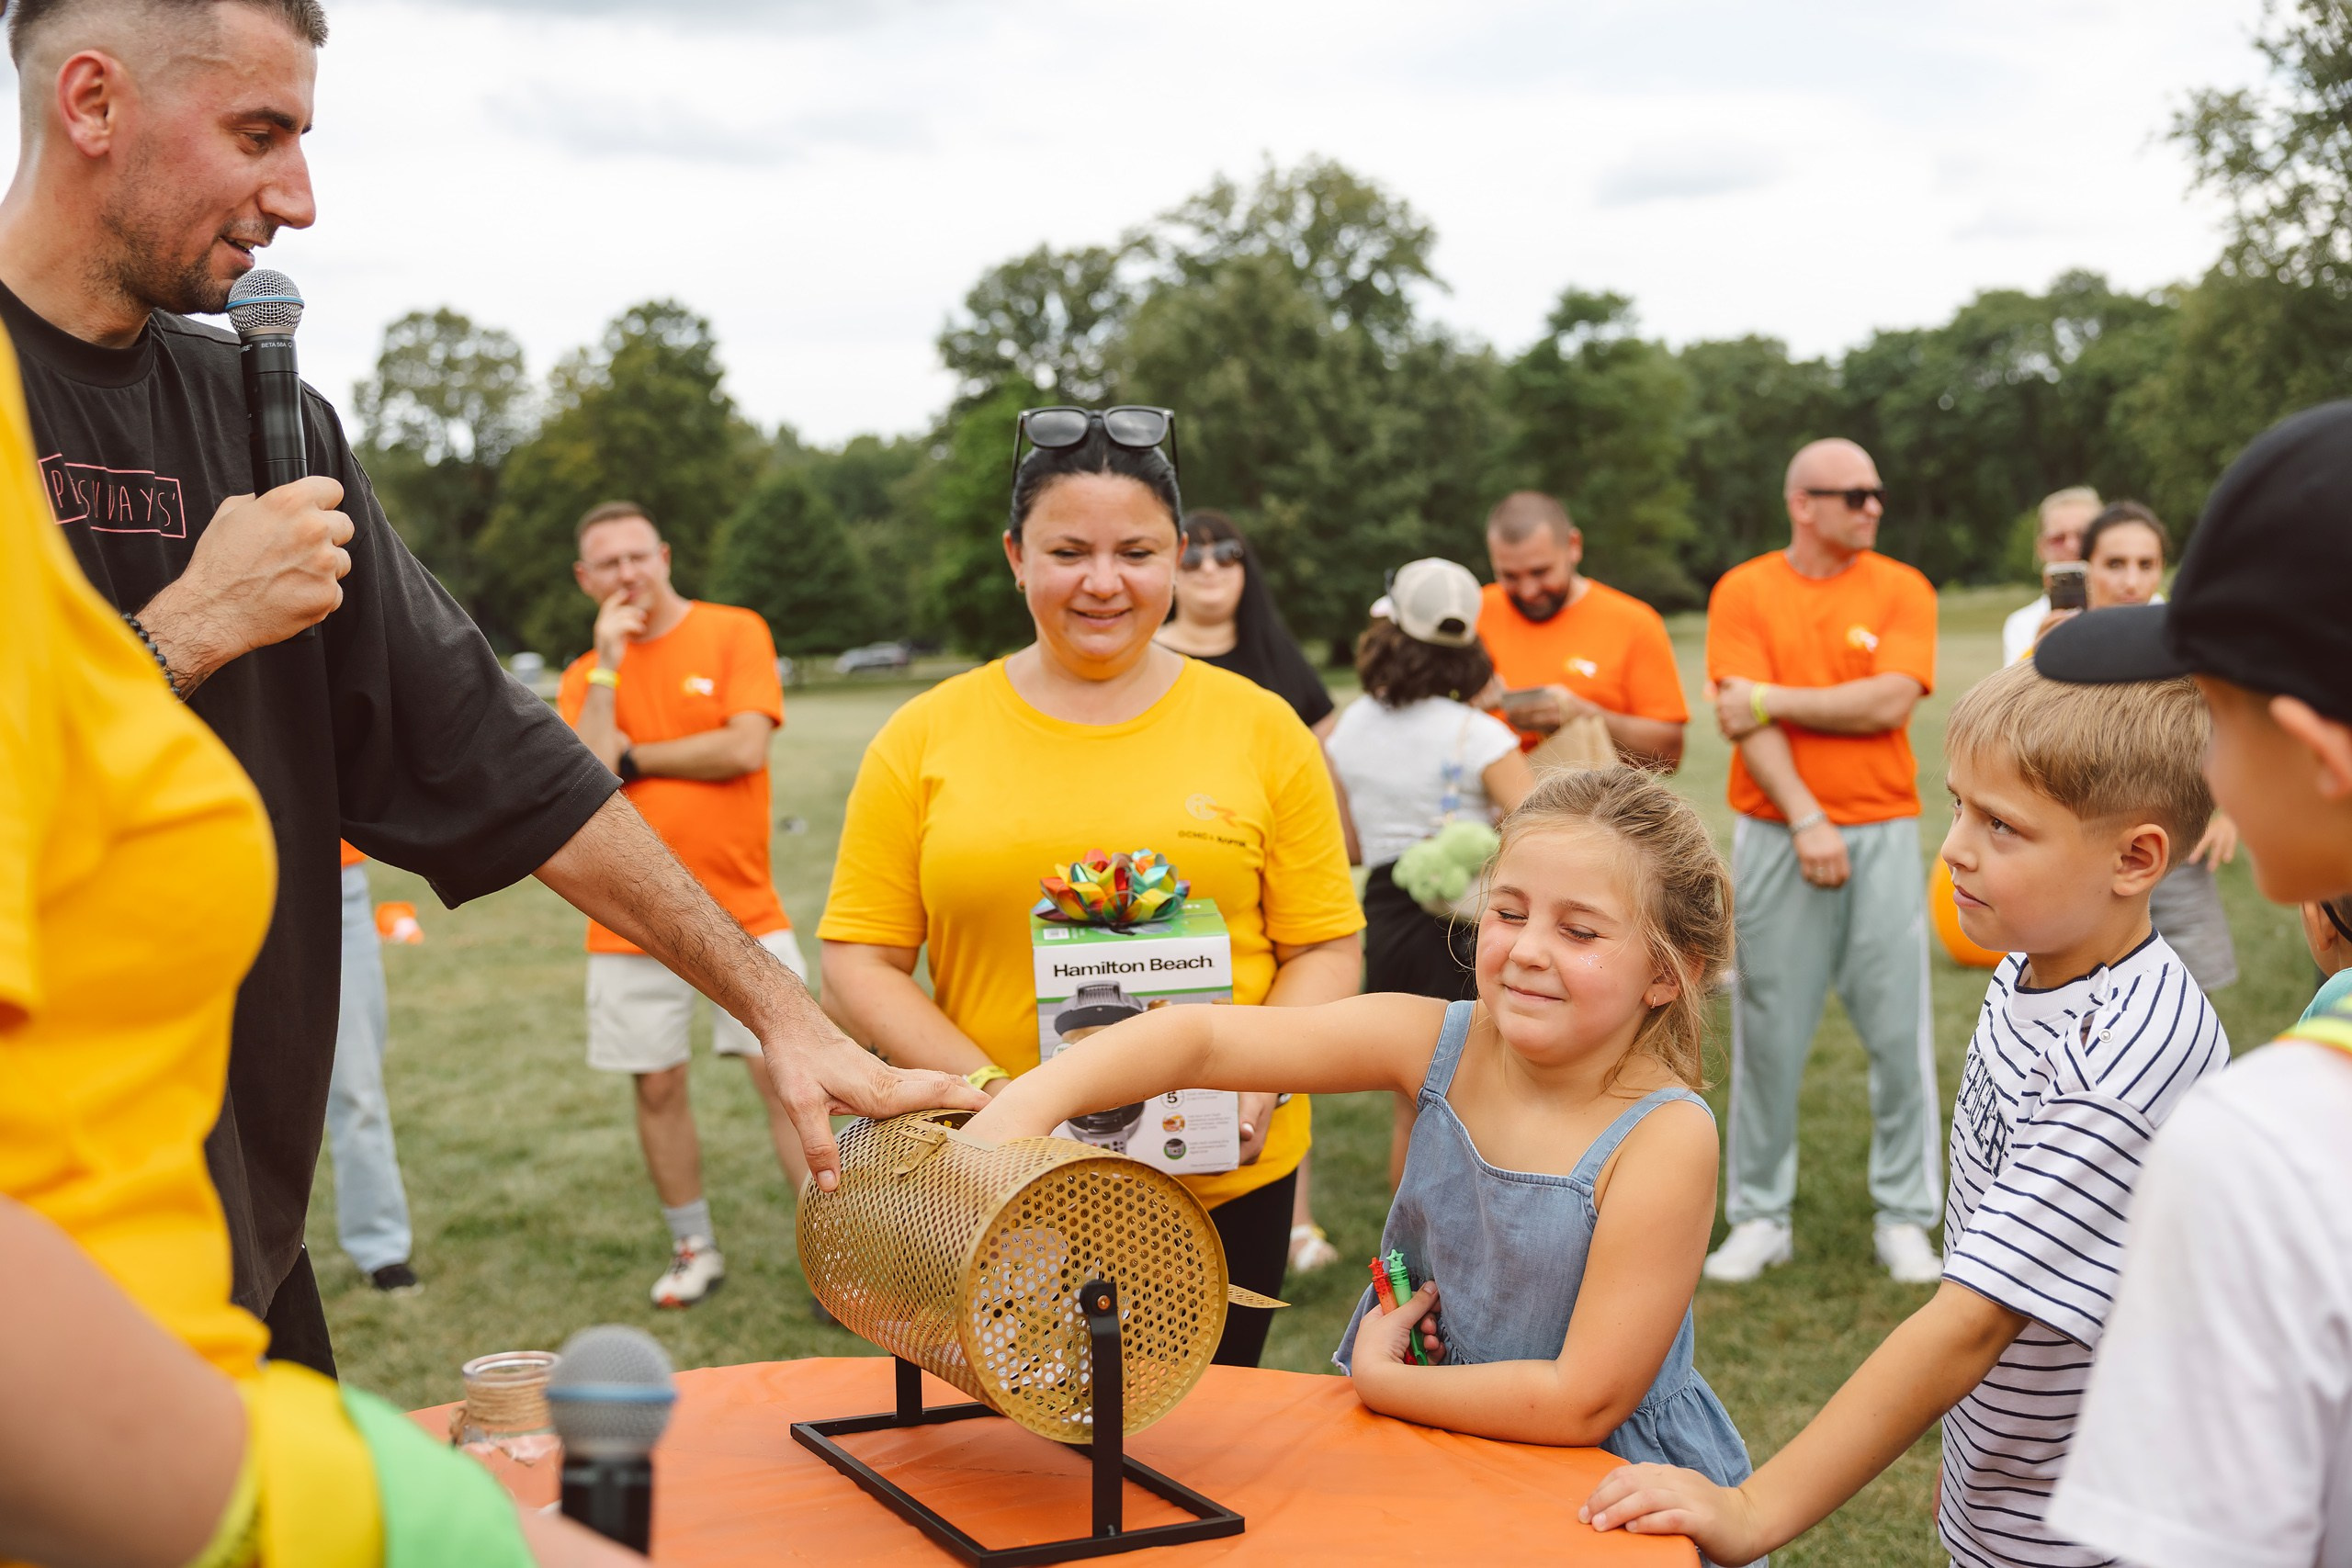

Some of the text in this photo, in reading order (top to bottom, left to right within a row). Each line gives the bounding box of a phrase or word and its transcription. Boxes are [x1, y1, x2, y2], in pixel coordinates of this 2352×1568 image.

[1054, 955, 1213, 977] Hamilton Beach
[1167, 1091, 1178, 1103] 5
